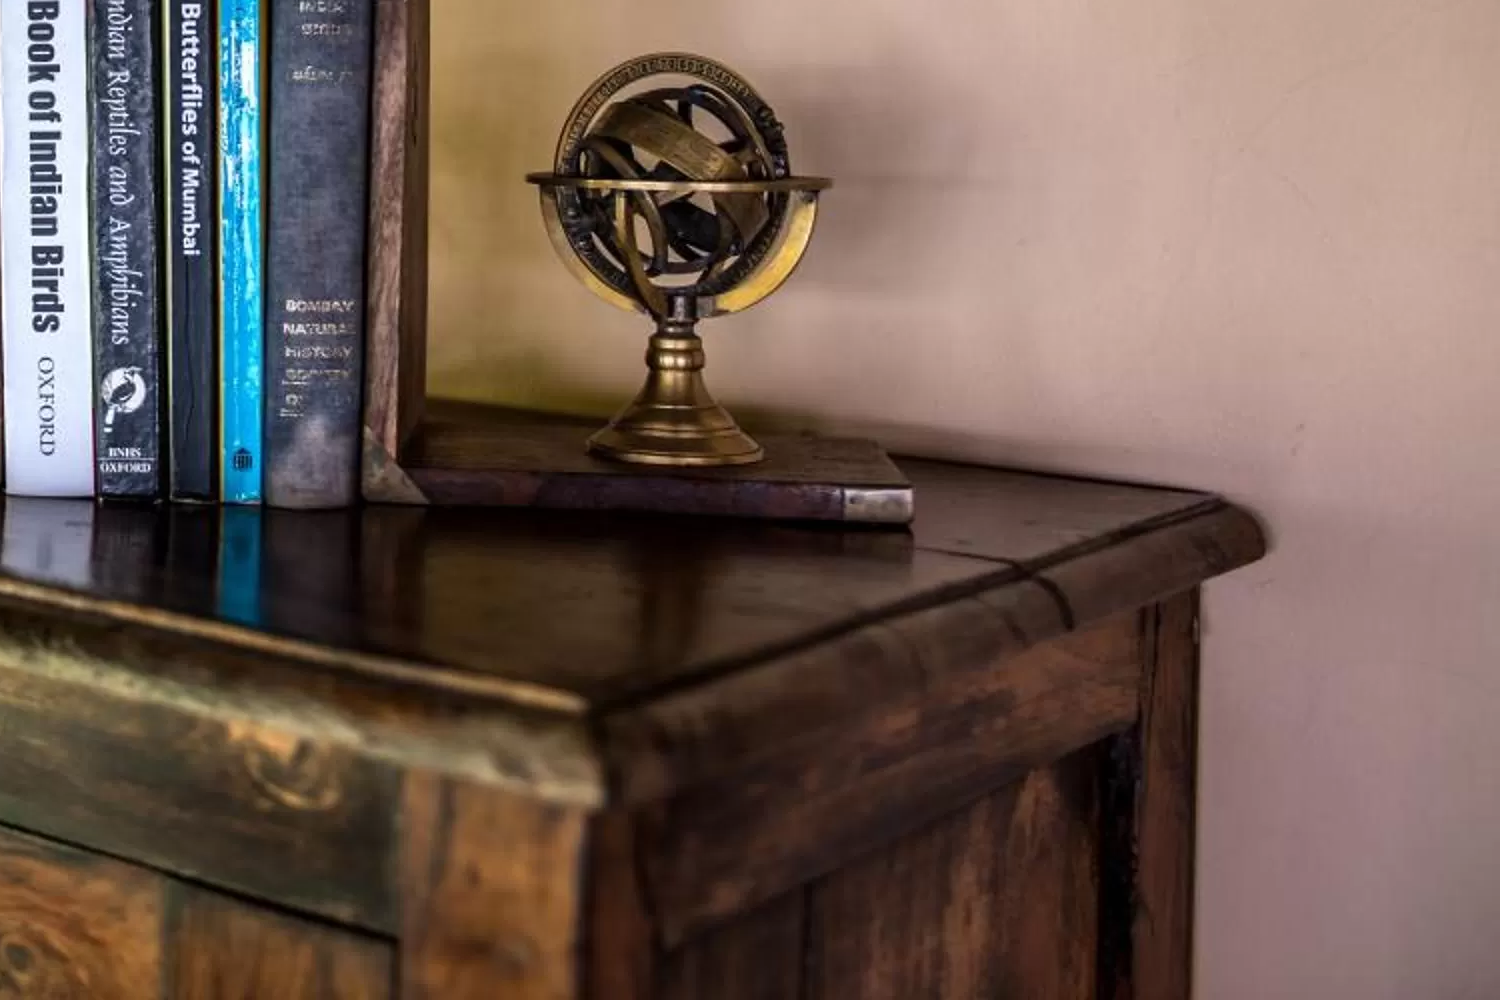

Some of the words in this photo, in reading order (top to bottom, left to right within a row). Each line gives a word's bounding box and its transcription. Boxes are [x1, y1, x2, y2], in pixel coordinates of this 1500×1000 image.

[27, 0, 61, 83] Book
[181, 3, 203, 136] Butterflies
[28, 90, 62, 123] of
[100, 69, 141, 157] Reptiles
[29, 131, 63, 237] Indian
[109, 165, 135, 206] and
[182, 141, 203, 165] of
[182, 169, 201, 256] Mumbai
[31, 245, 65, 333] Birds
[102, 216, 144, 345] Amphibians
[38, 356, 56, 457] OXFORD
[100, 462, 151, 473] OXFORD
